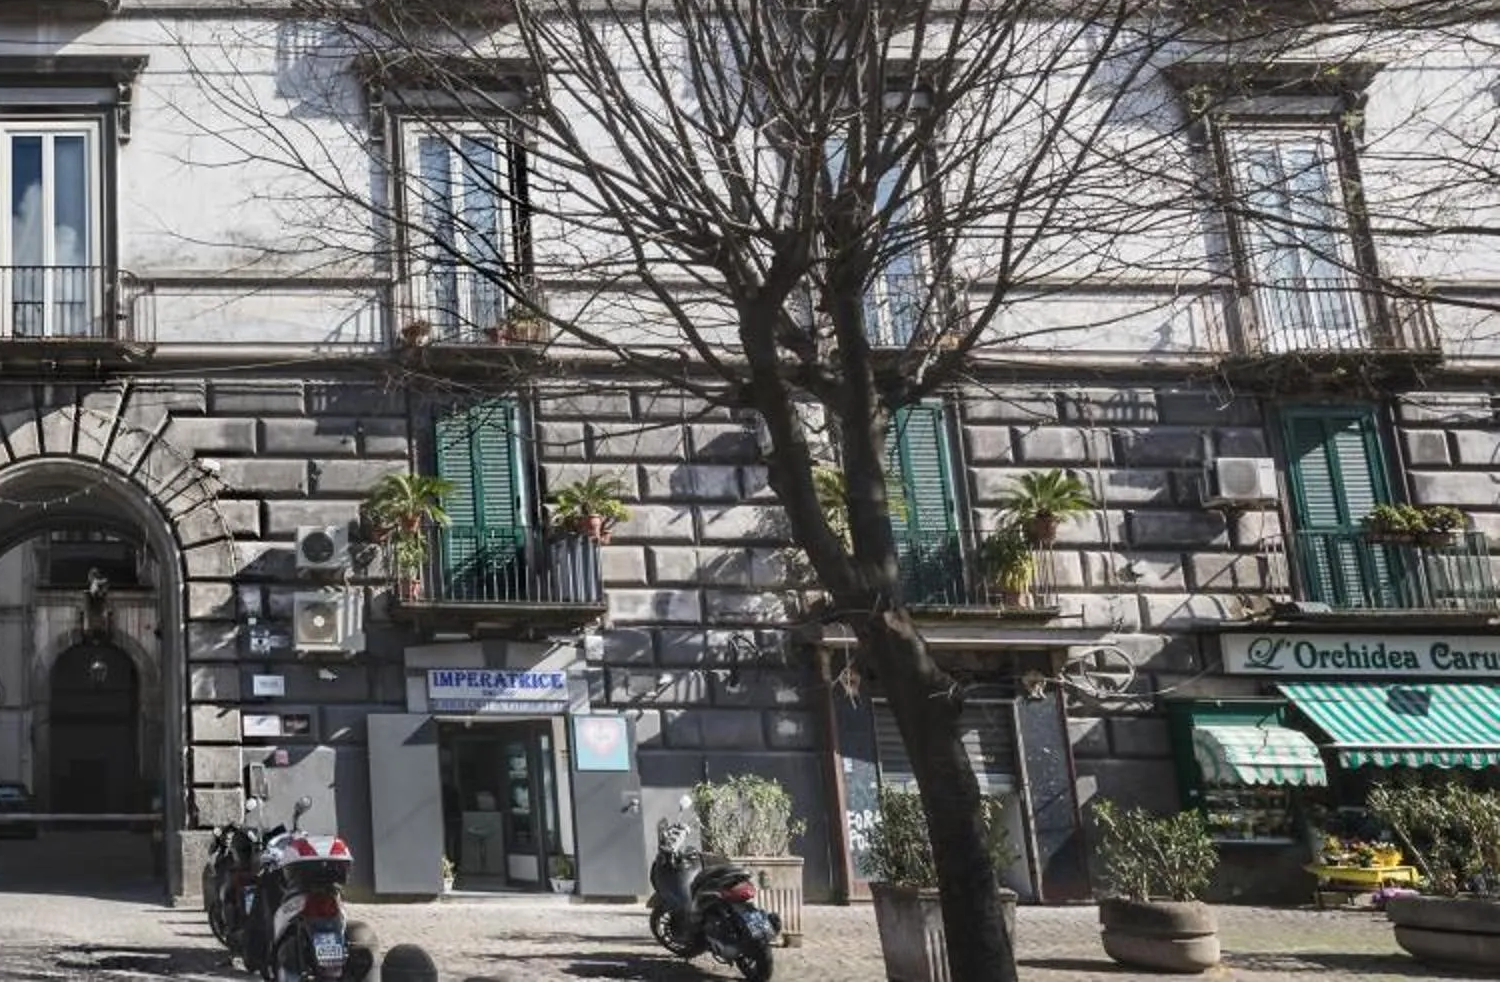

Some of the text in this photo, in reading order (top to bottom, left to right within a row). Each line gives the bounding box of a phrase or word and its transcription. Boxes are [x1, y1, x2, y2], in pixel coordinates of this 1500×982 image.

[1244, 637, 1500, 670] L'Orchidea Caru
[433, 671, 564, 689] IMPERATRICE
